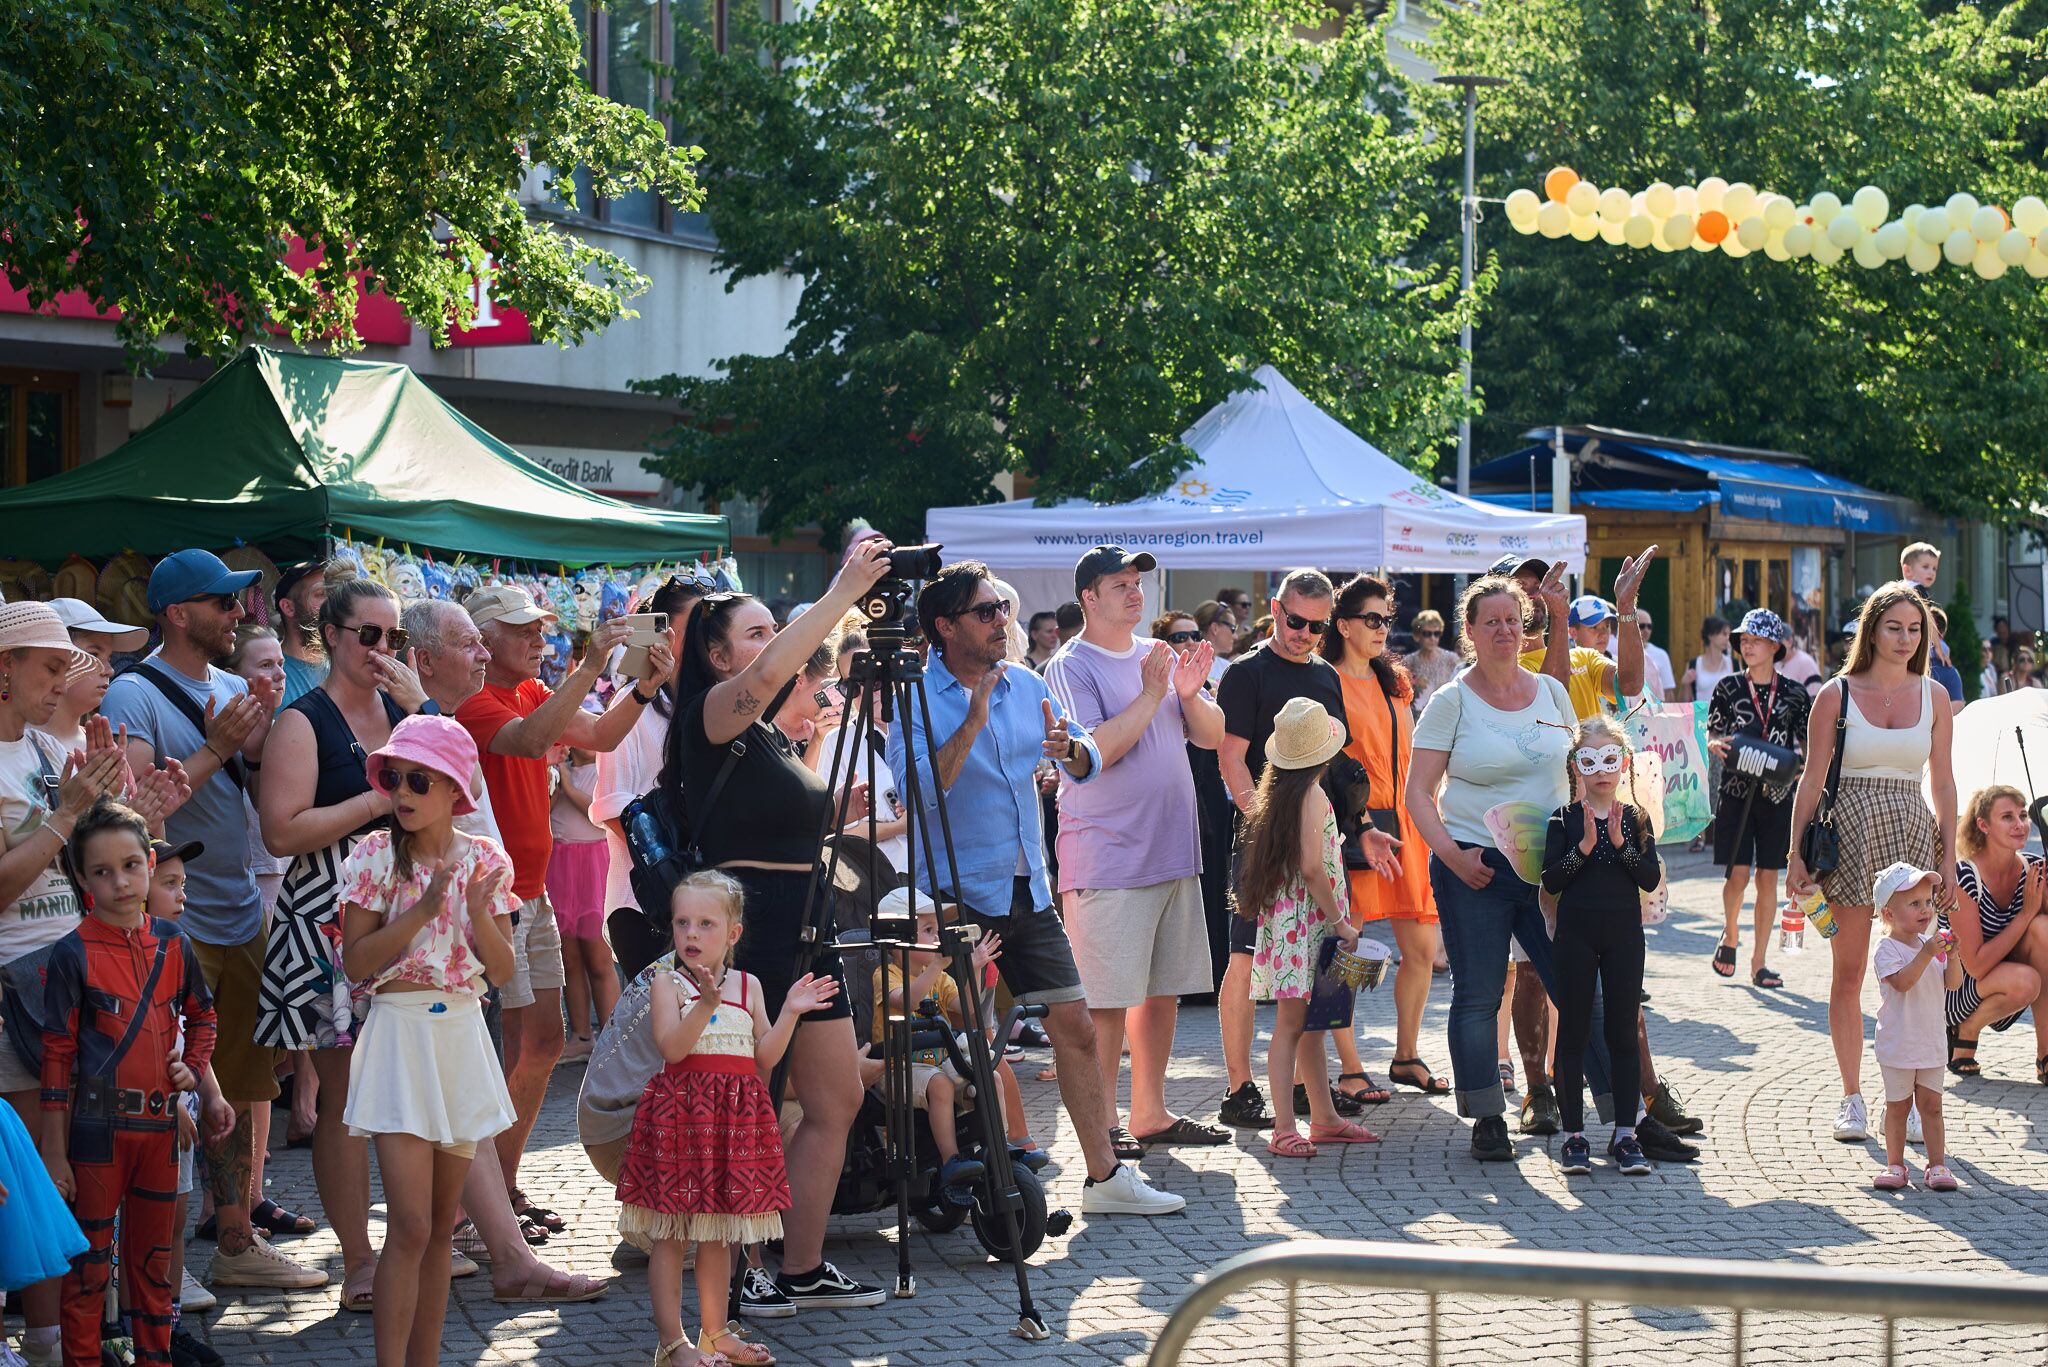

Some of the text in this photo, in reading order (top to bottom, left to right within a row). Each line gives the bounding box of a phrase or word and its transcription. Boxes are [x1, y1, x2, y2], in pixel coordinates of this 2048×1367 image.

[581, 460, 614, 483] Bank
[1034, 529, 1263, 547] www.bratislavaregion.travel
[1736, 744, 1768, 778] 1000
